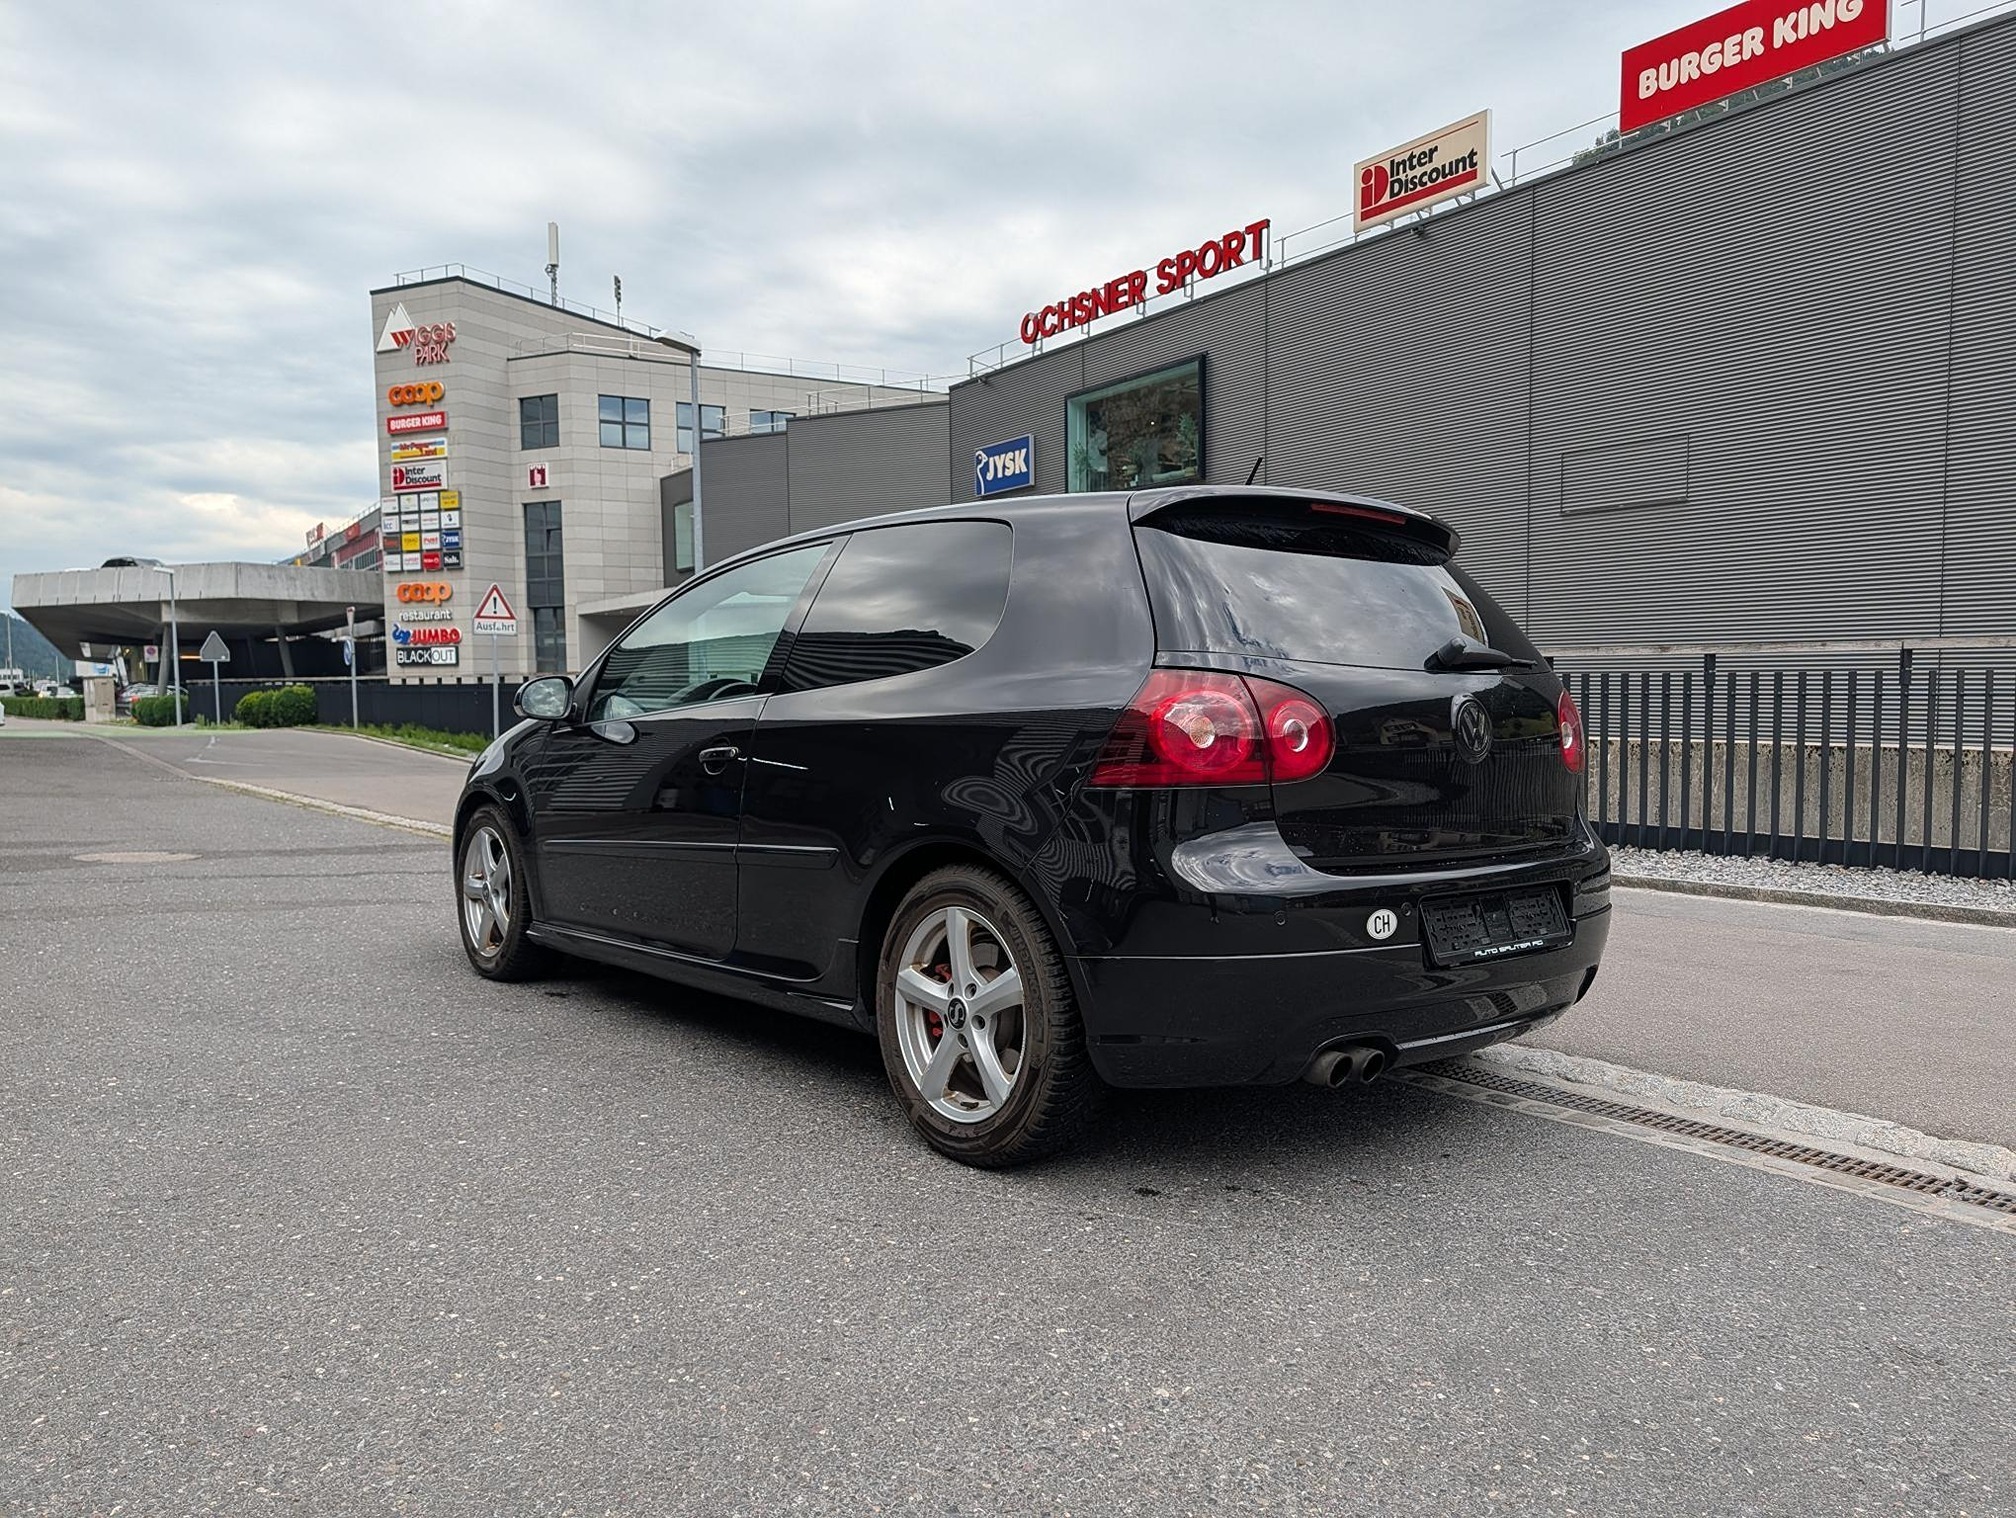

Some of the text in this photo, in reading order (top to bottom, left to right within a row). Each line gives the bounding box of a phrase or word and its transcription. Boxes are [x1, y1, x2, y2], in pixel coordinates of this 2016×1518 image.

[1638, 0, 1864, 100] BURGER KING
[1389, 145, 1438, 179] Inter
[1389, 147, 1478, 199] Discount
[1020, 218, 1270, 344] OCHSNER SPORT
[415, 342, 449, 365] PARK
[388, 381, 445, 407] coop
[390, 415, 442, 430] BURGER KING
[405, 466, 425, 475] Inter
[986, 448, 1028, 481] JYSK
[405, 474, 442, 484] Discount
[397, 582, 453, 607] coop
[399, 609, 452, 622] restaurant
[410, 626, 462, 645] JUMBO
[397, 649, 456, 664] BLACKOUT
[1374, 914, 1391, 934] CH
[1474, 947, 1498, 957] AUTO
